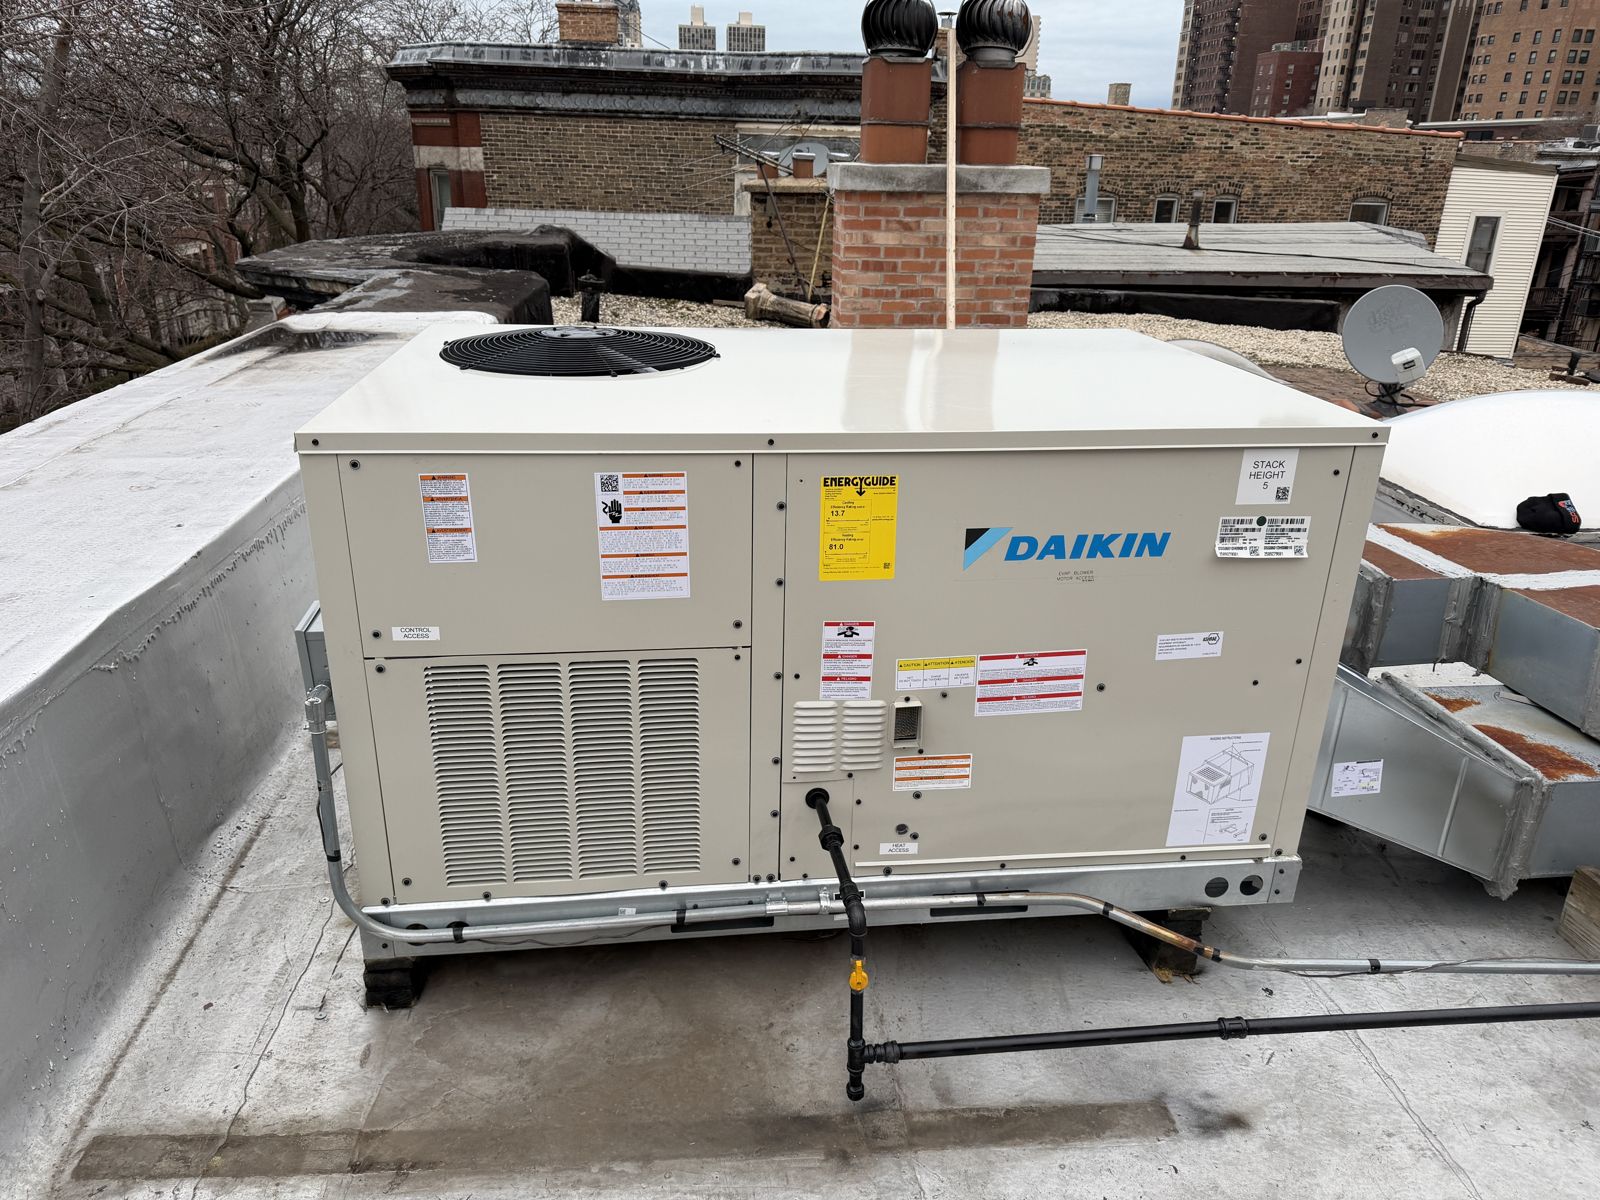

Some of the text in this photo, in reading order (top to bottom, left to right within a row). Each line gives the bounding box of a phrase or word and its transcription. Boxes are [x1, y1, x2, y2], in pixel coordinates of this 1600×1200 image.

[1252, 460, 1286, 469] STACK
[1249, 470, 1286, 480] HEIGHT
[823, 476, 897, 488] ENERGYGUIDE
[1262, 481, 1269, 490] 5
[1004, 532, 1172, 561] DAIKIN
